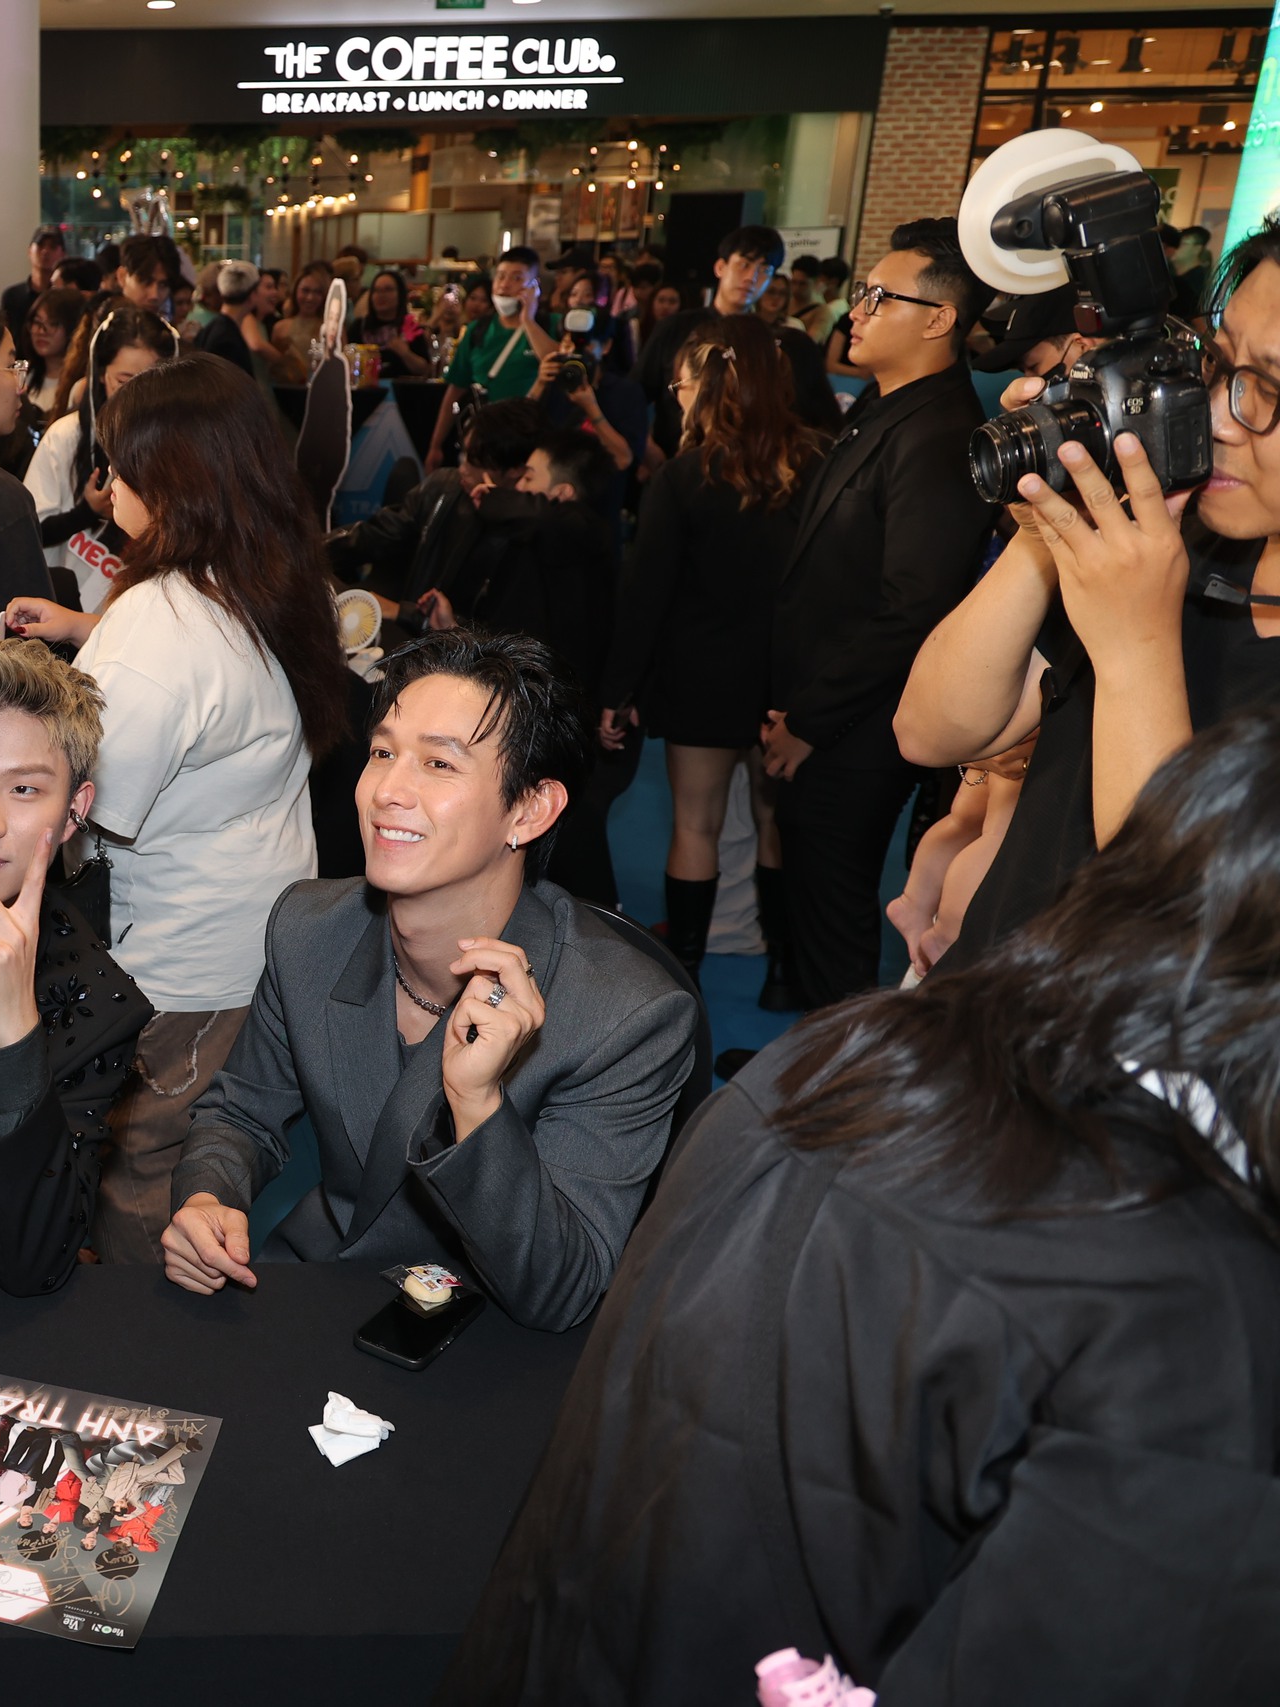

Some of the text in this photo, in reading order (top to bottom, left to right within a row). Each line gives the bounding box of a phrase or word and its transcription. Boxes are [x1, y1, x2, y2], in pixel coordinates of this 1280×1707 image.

[264, 42, 330, 79] THE
[335, 36, 509, 81] COFFEE
[261, 89, 589, 114] BREAKFAST LUNCH DINNER
[1126, 397, 1144, 407] EOS
[79, 1410, 165, 1447] ANH
[63, 1617, 79, 1631] Vie
